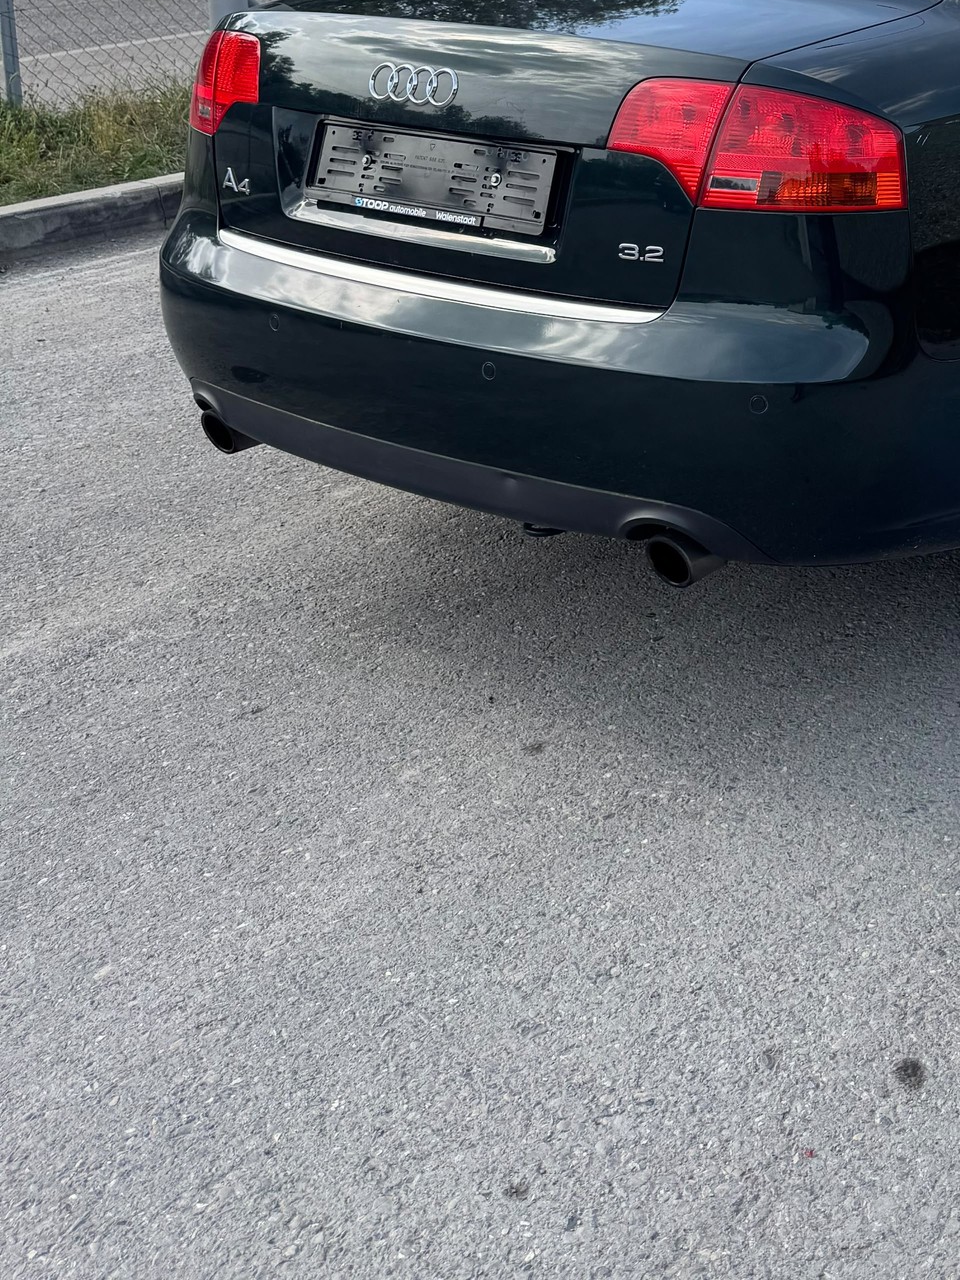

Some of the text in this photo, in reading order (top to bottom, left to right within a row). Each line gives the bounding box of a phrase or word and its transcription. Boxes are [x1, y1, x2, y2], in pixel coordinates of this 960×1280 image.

[222, 166, 250, 196] A4
[389, 204, 427, 217] automobile
[435, 210, 477, 225] Walenstadt
[618, 243, 664, 263] 3.2
